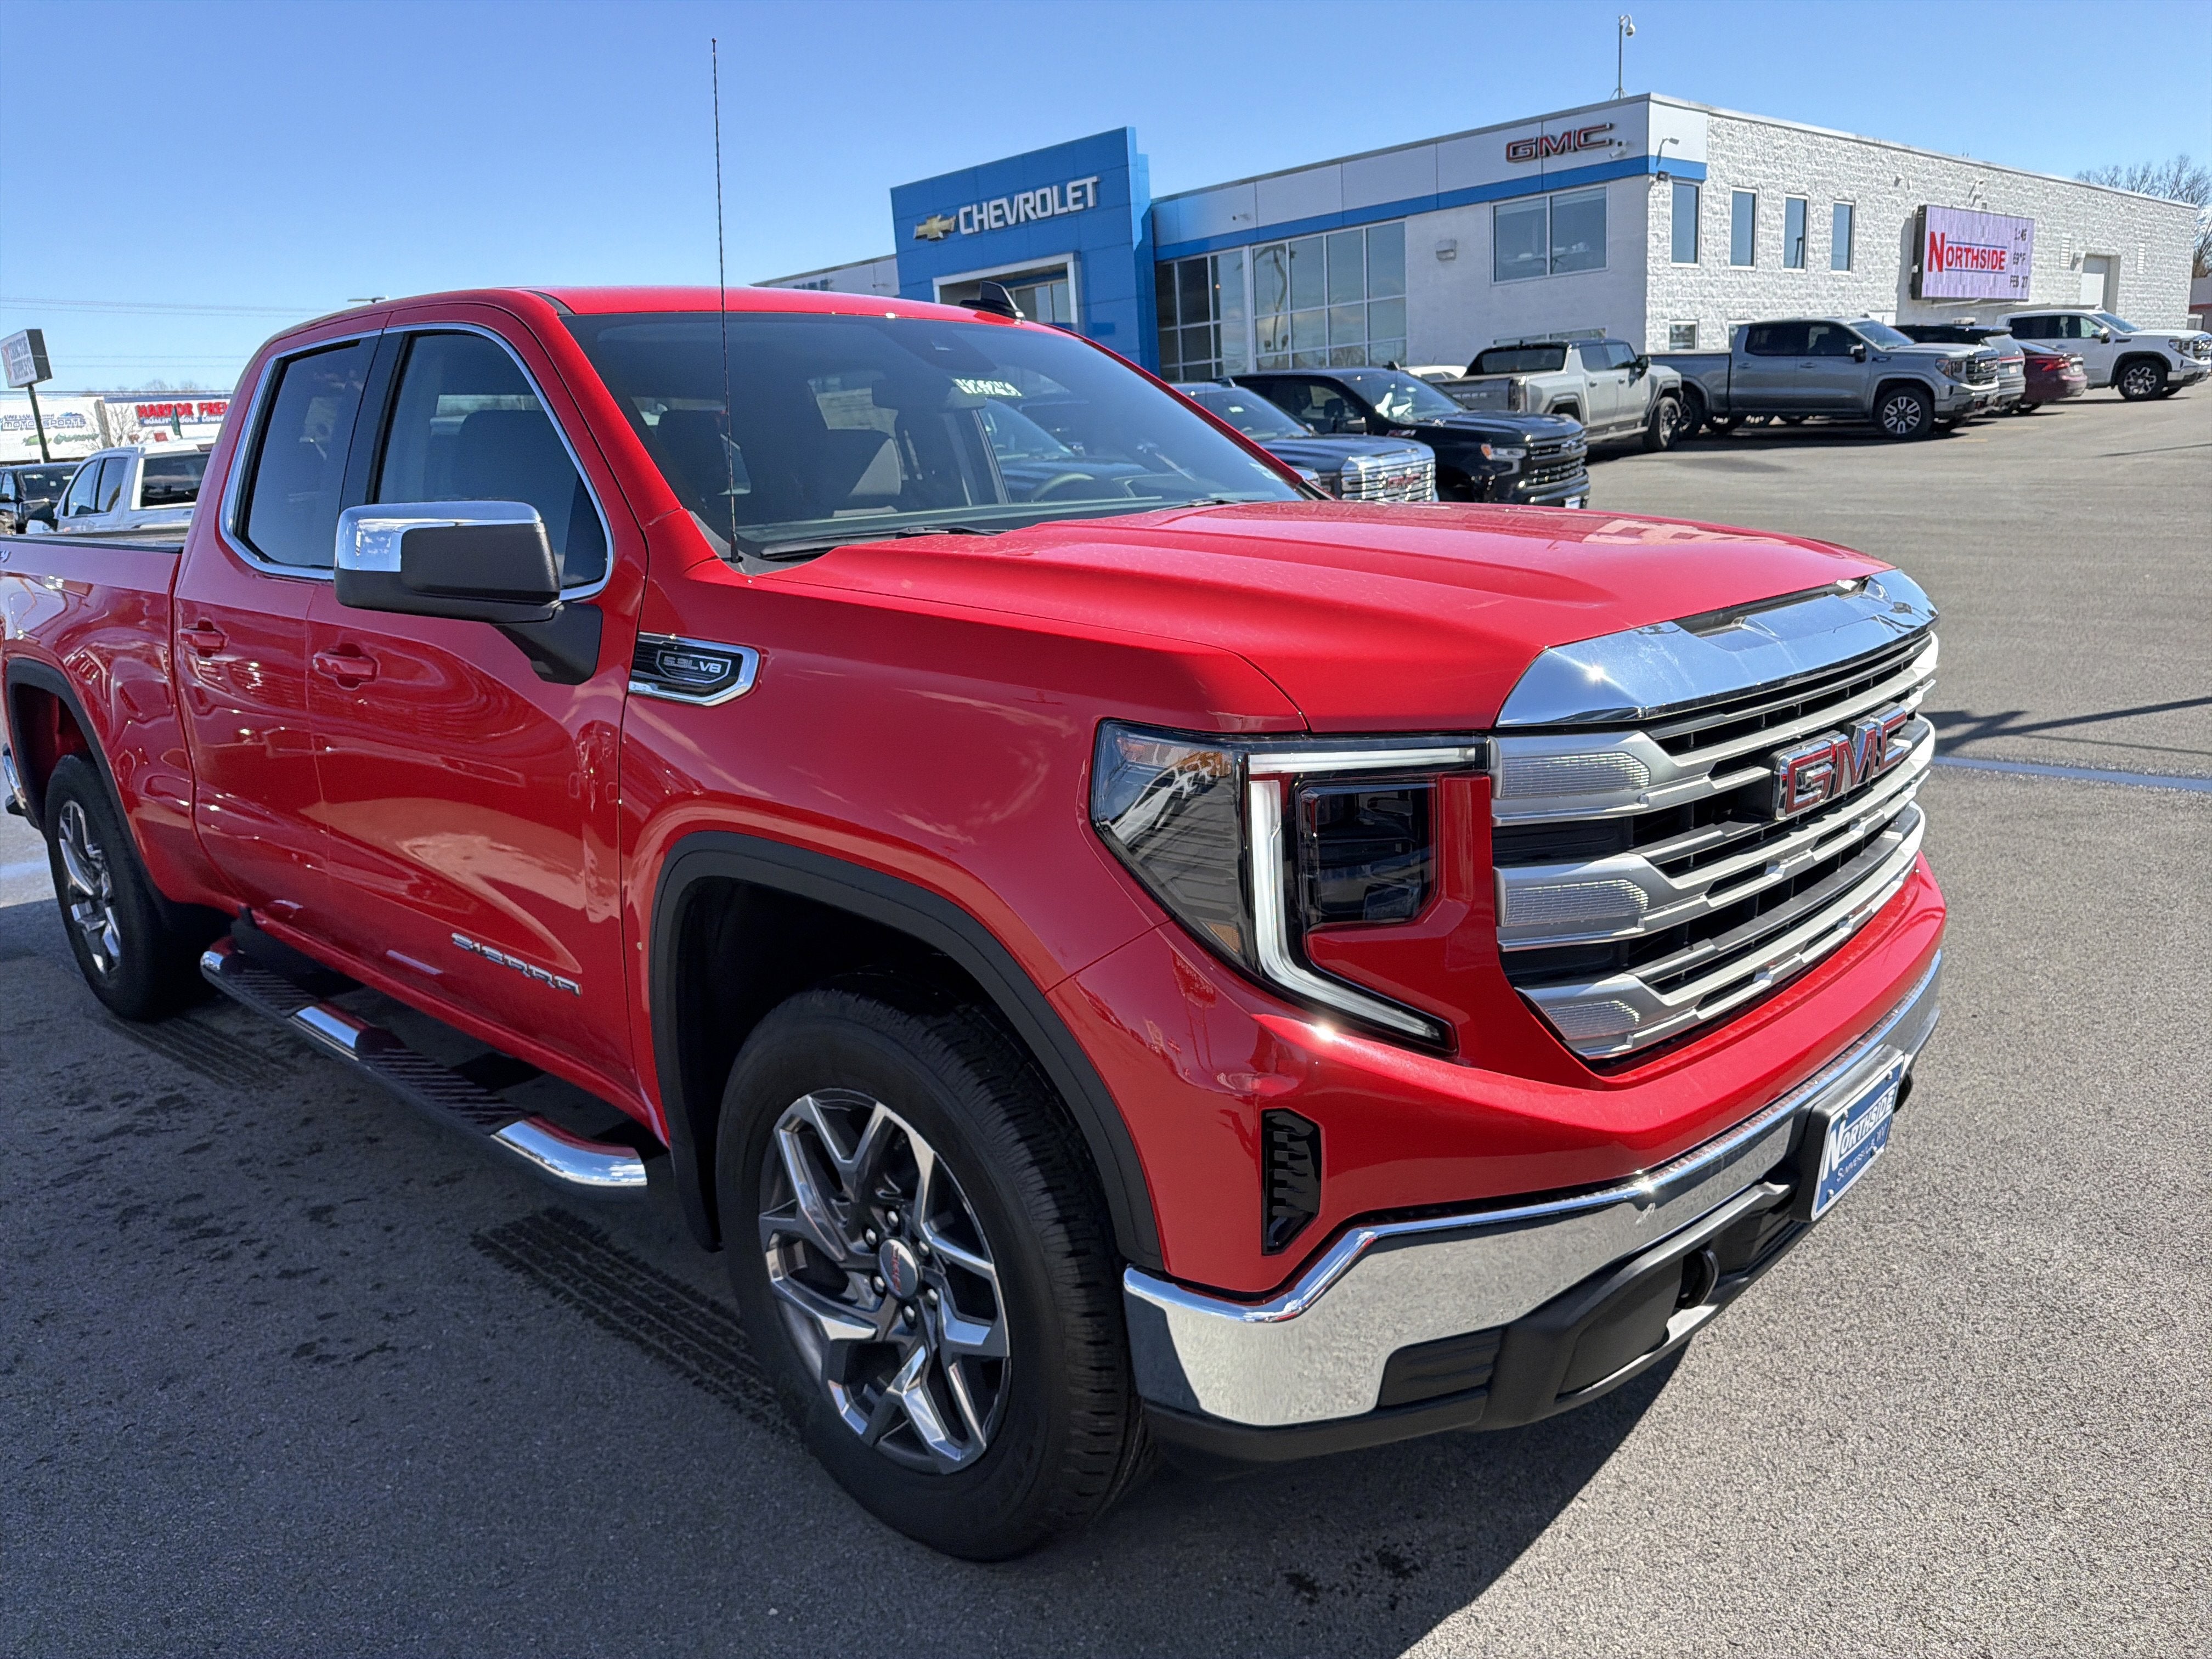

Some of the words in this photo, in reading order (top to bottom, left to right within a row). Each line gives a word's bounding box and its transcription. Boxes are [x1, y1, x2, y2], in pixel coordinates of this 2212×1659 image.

[1506, 123, 1611, 163] GMC
[958, 176, 1099, 235] CHEVROLET
[1927, 232, 2006, 273] NORTHSIDE
[3, 417, 86, 430] MOTOSPORTS
[1776, 706, 1907, 821] GMC
[451, 932, 582, 997] SIERRA
[1821, 1088, 1895, 1182] NORTHSIDE
